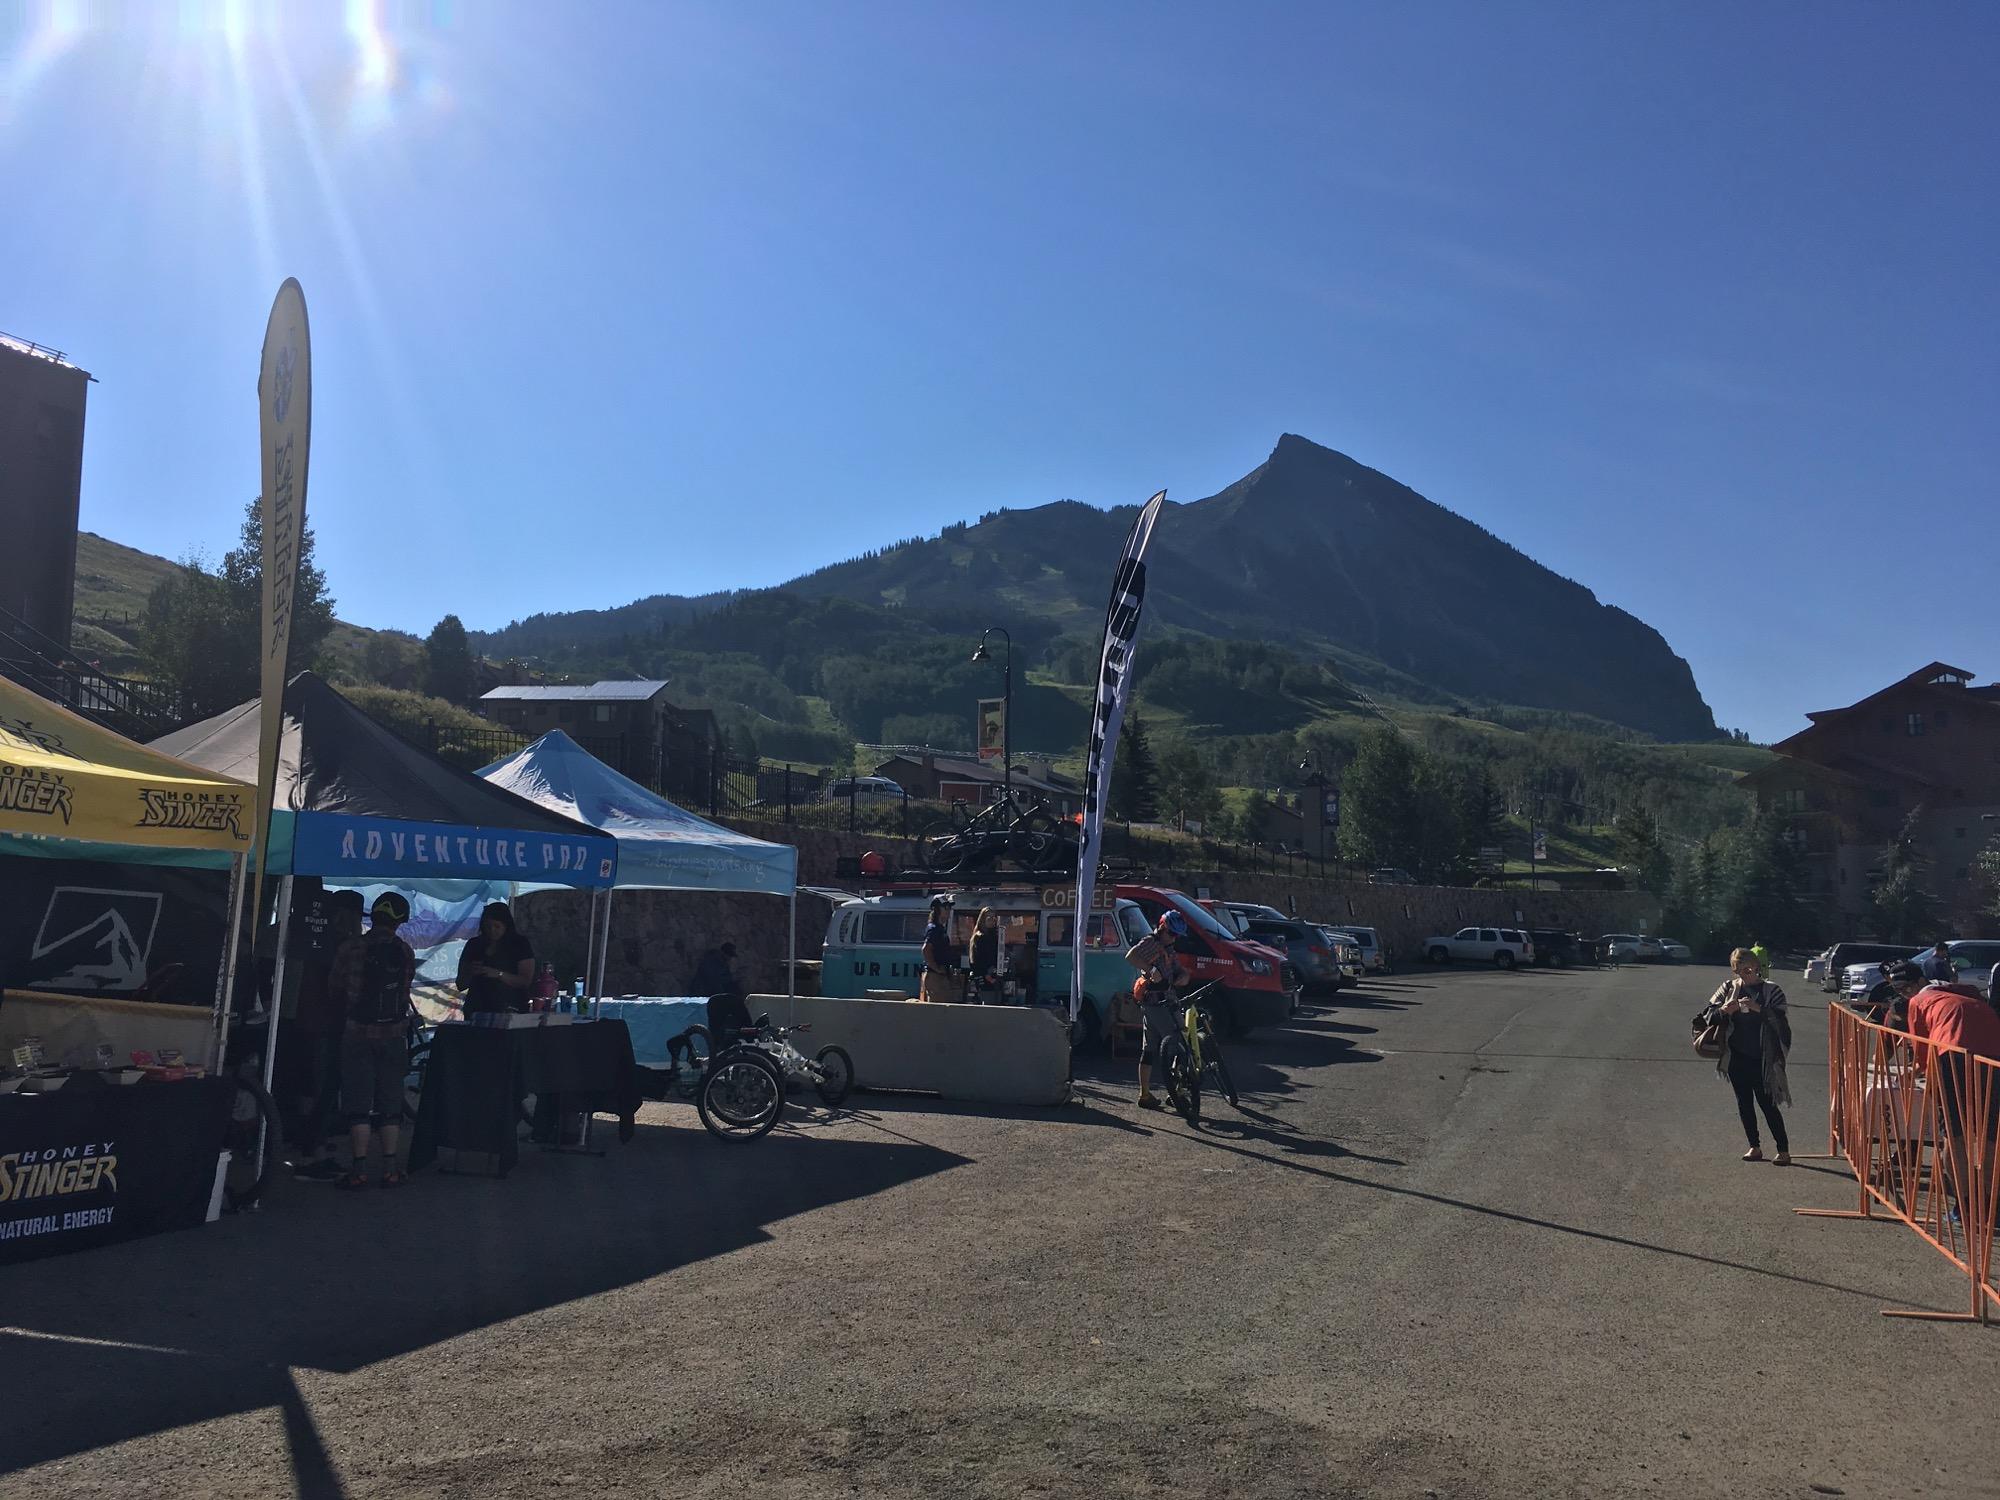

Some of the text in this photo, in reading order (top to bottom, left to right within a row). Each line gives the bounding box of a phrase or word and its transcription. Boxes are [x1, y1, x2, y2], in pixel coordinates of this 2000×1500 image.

[272, 434, 293, 660] STINGER
[3, 766, 64, 784] ONEY
[0, 775, 73, 825] NGER
[136, 788, 242, 839] STINGER
[168, 791, 239, 803] HONEY
[341, 829, 528, 867] ADVENTURE
[542, 843, 588, 870] PRO
[1043, 888, 1113, 908] COFEE
[22, 1142, 114, 1163] HONEY
[0, 1153, 119, 1203] STINGER
[0, 1206, 115, 1240] NATURAL ENERGY
